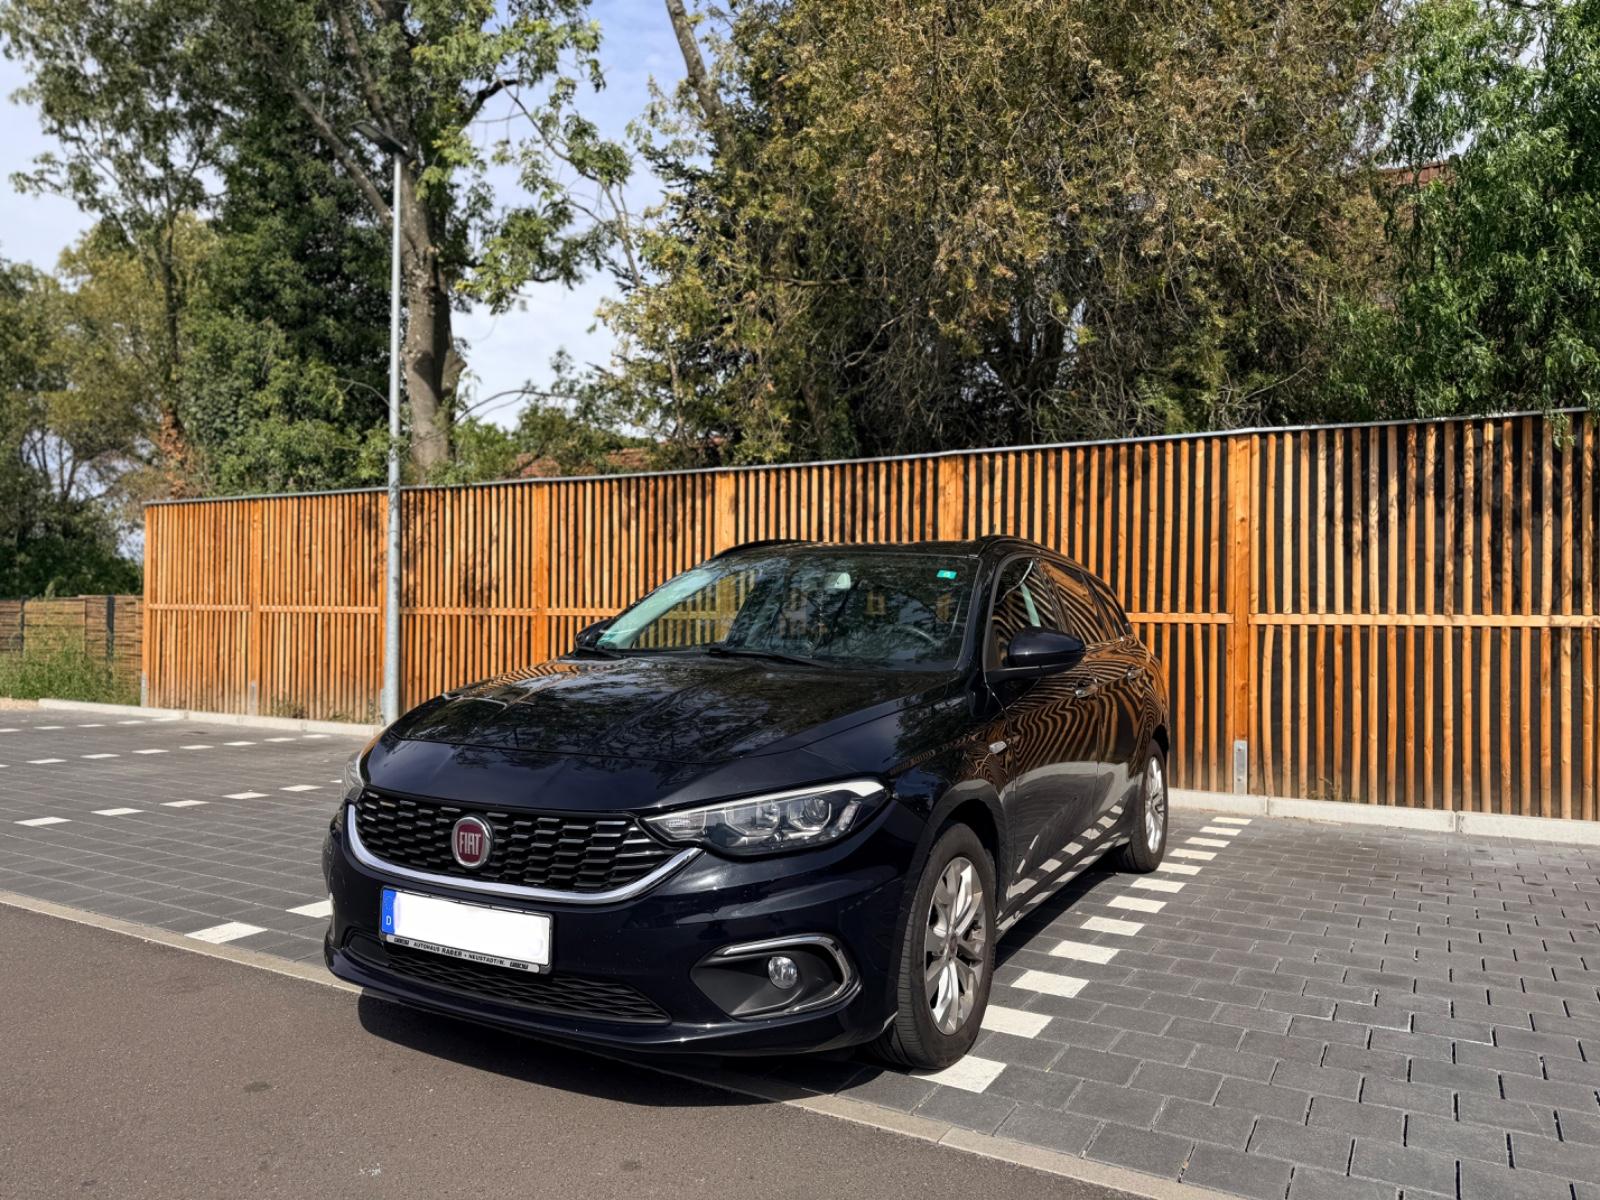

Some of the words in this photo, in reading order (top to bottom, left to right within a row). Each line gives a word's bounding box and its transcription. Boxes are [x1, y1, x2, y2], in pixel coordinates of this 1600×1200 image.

[459, 832, 482, 855] FIAT
[386, 915, 391, 925] D
[414, 942, 440, 952] AUTOHAUS
